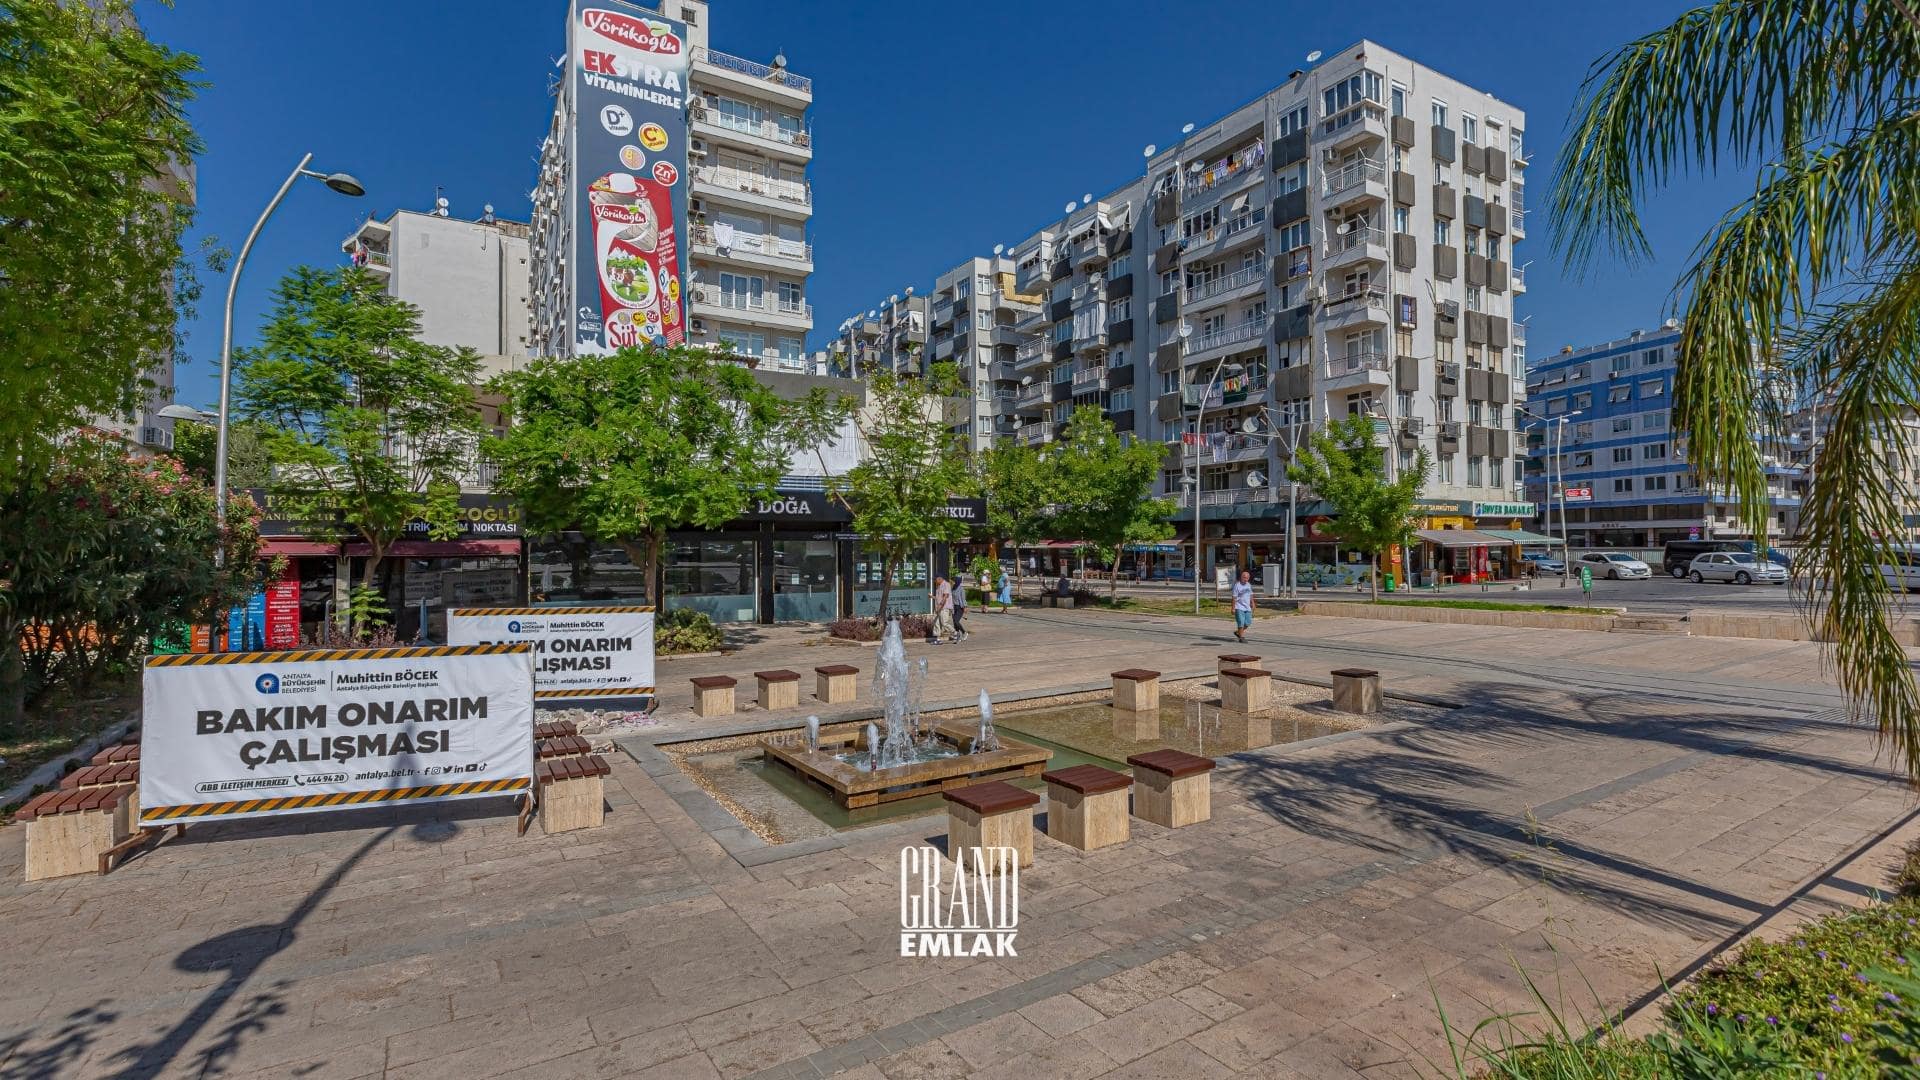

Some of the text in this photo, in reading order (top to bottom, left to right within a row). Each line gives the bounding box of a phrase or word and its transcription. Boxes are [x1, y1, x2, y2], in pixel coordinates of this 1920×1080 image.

[583, 49, 681, 92] EKSTRA
[583, 73, 682, 109] VİTAMİNLERLE
[608, 321, 637, 348] Süt
[757, 496, 812, 515] DOĞA
[473, 523, 517, 532] NOKTASI
[549, 621, 580, 629] Muhittin
[581, 620, 605, 628] BÖCEK
[551, 637, 632, 653] ONARIM
[281, 679, 326, 687] BÜYÜKŞEHİR
[336, 669, 438, 684] Muhittin BÖCEK
[281, 686, 317, 694] BELEDİYESİ
[196, 696, 488, 735] BAKIM ONARIM
[240, 729, 450, 770] ÇALIŞMASI
[200, 774, 345, 792] ABB İLETİŞİM MERKEZİ 444 94 20
[355, 769, 414, 781] antalya.bel.tr
